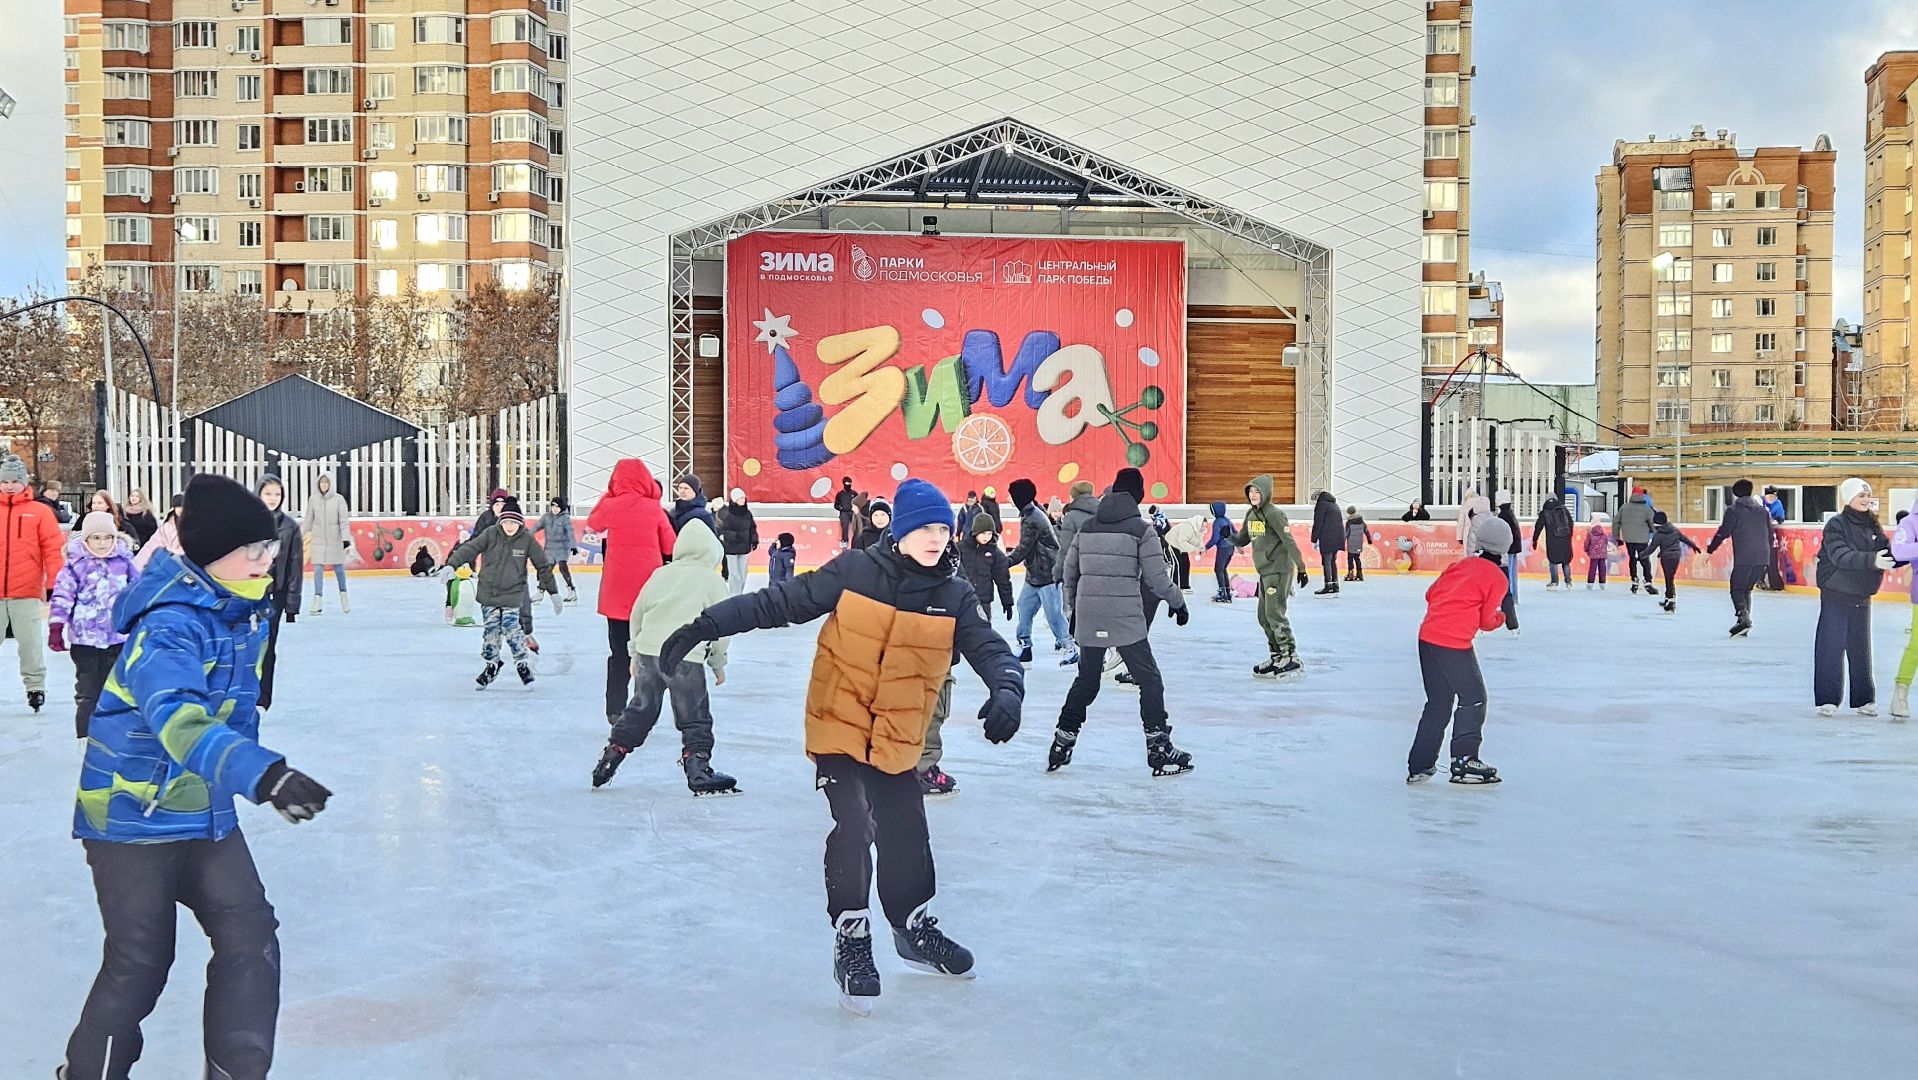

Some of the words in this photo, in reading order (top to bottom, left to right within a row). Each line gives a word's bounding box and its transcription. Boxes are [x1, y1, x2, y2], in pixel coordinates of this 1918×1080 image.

[880, 257, 924, 268] ПАРКИ
[1038, 259, 1117, 271] ЦЕНТРАЛЬНЫЙ
[880, 270, 983, 283] ПОДМОСКОВЬЯ
[1038, 274, 1066, 284] ПАРК
[1067, 275, 1113, 285] ПОБЕДЫ
